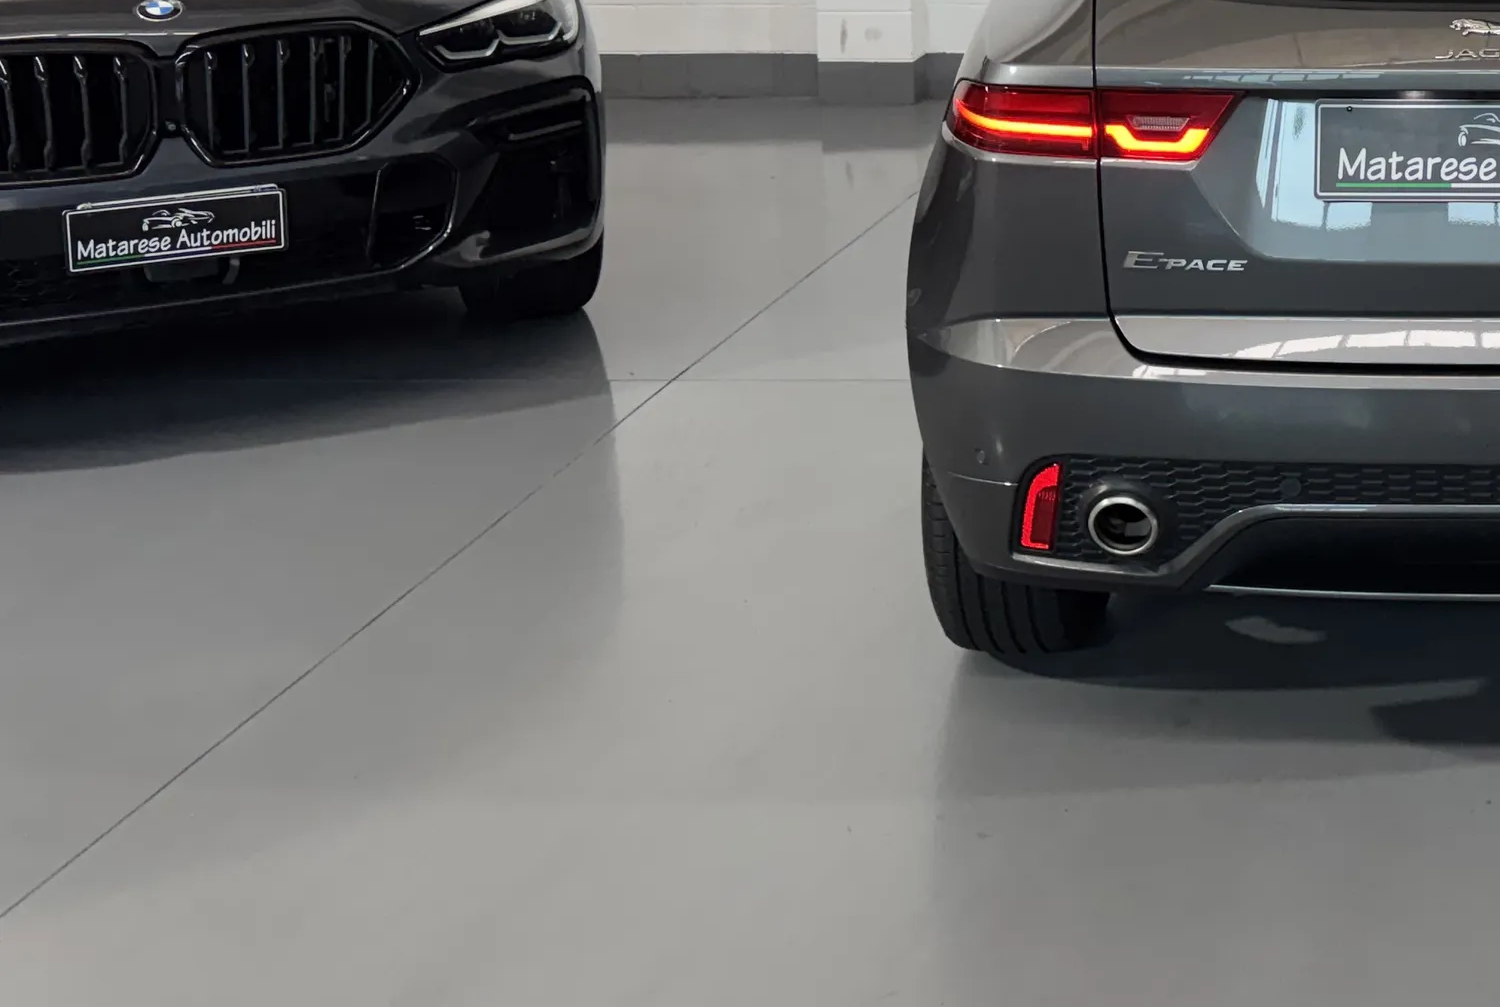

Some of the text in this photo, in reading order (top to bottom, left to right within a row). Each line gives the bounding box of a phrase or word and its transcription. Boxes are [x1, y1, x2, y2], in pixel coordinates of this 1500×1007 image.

[1337, 147, 1497, 182] Matarese
[77, 220, 276, 261] Matarese Automobili
